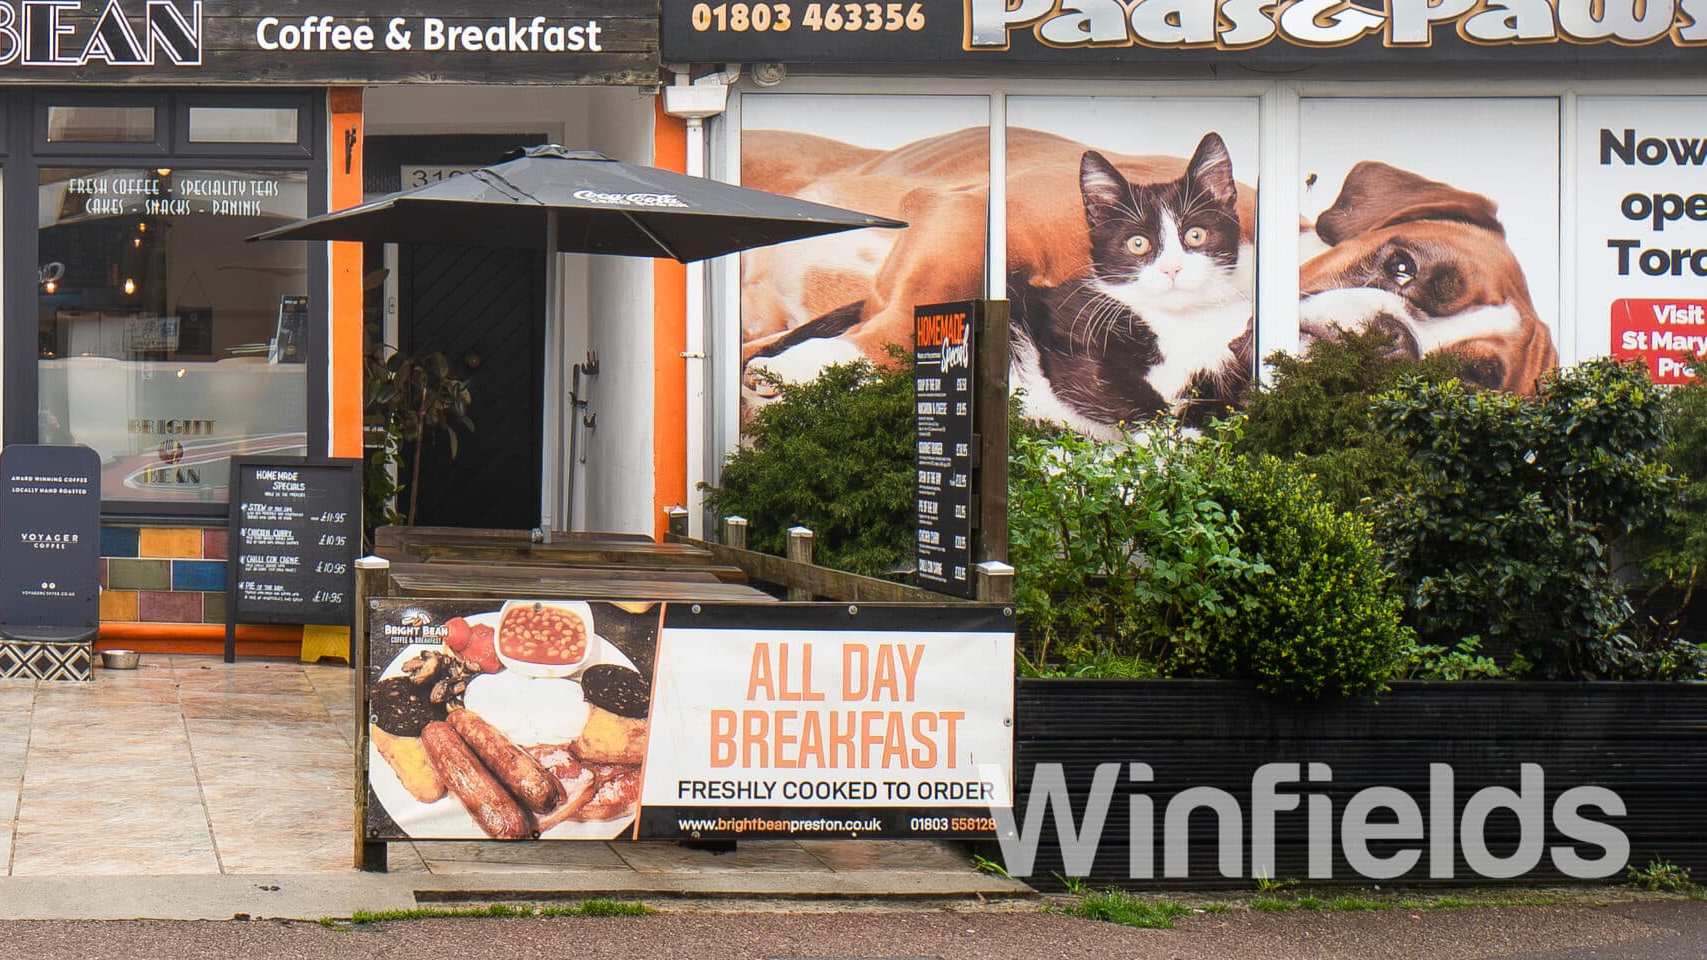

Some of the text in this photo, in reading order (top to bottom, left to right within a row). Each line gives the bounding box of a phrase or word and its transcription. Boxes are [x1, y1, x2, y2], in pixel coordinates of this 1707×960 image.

[691, 1, 926, 33] 01803 463356
[256, 17, 380, 52] Coffee
[385, 18, 411, 52] &
[423, 16, 602, 53] Breakfast
[1600, 128, 1707, 166] Now
[69, 178, 279, 197] FRESH COFFEE SPECIALITY TEAS
[85, 198, 261, 216] CAKES SNACKS PANINIS
[1652, 304, 1706, 325] Visit
[917, 313, 966, 347] HOMEMADE
[1621, 330, 1648, 350] St
[273, 481, 306, 491] SPECIALS
[21, 533, 79, 542] VOYAGER
[384, 624, 448, 637] BRIGHT BEAN
[747, 642, 926, 703] ALL DAY
[710, 709, 966, 770] BREAKFAST
[678, 780, 996, 801] FRESHLY COOKED TO ORDER
[679, 817, 997, 834] www.brightbeanpreston.co.uk 01803 558128
